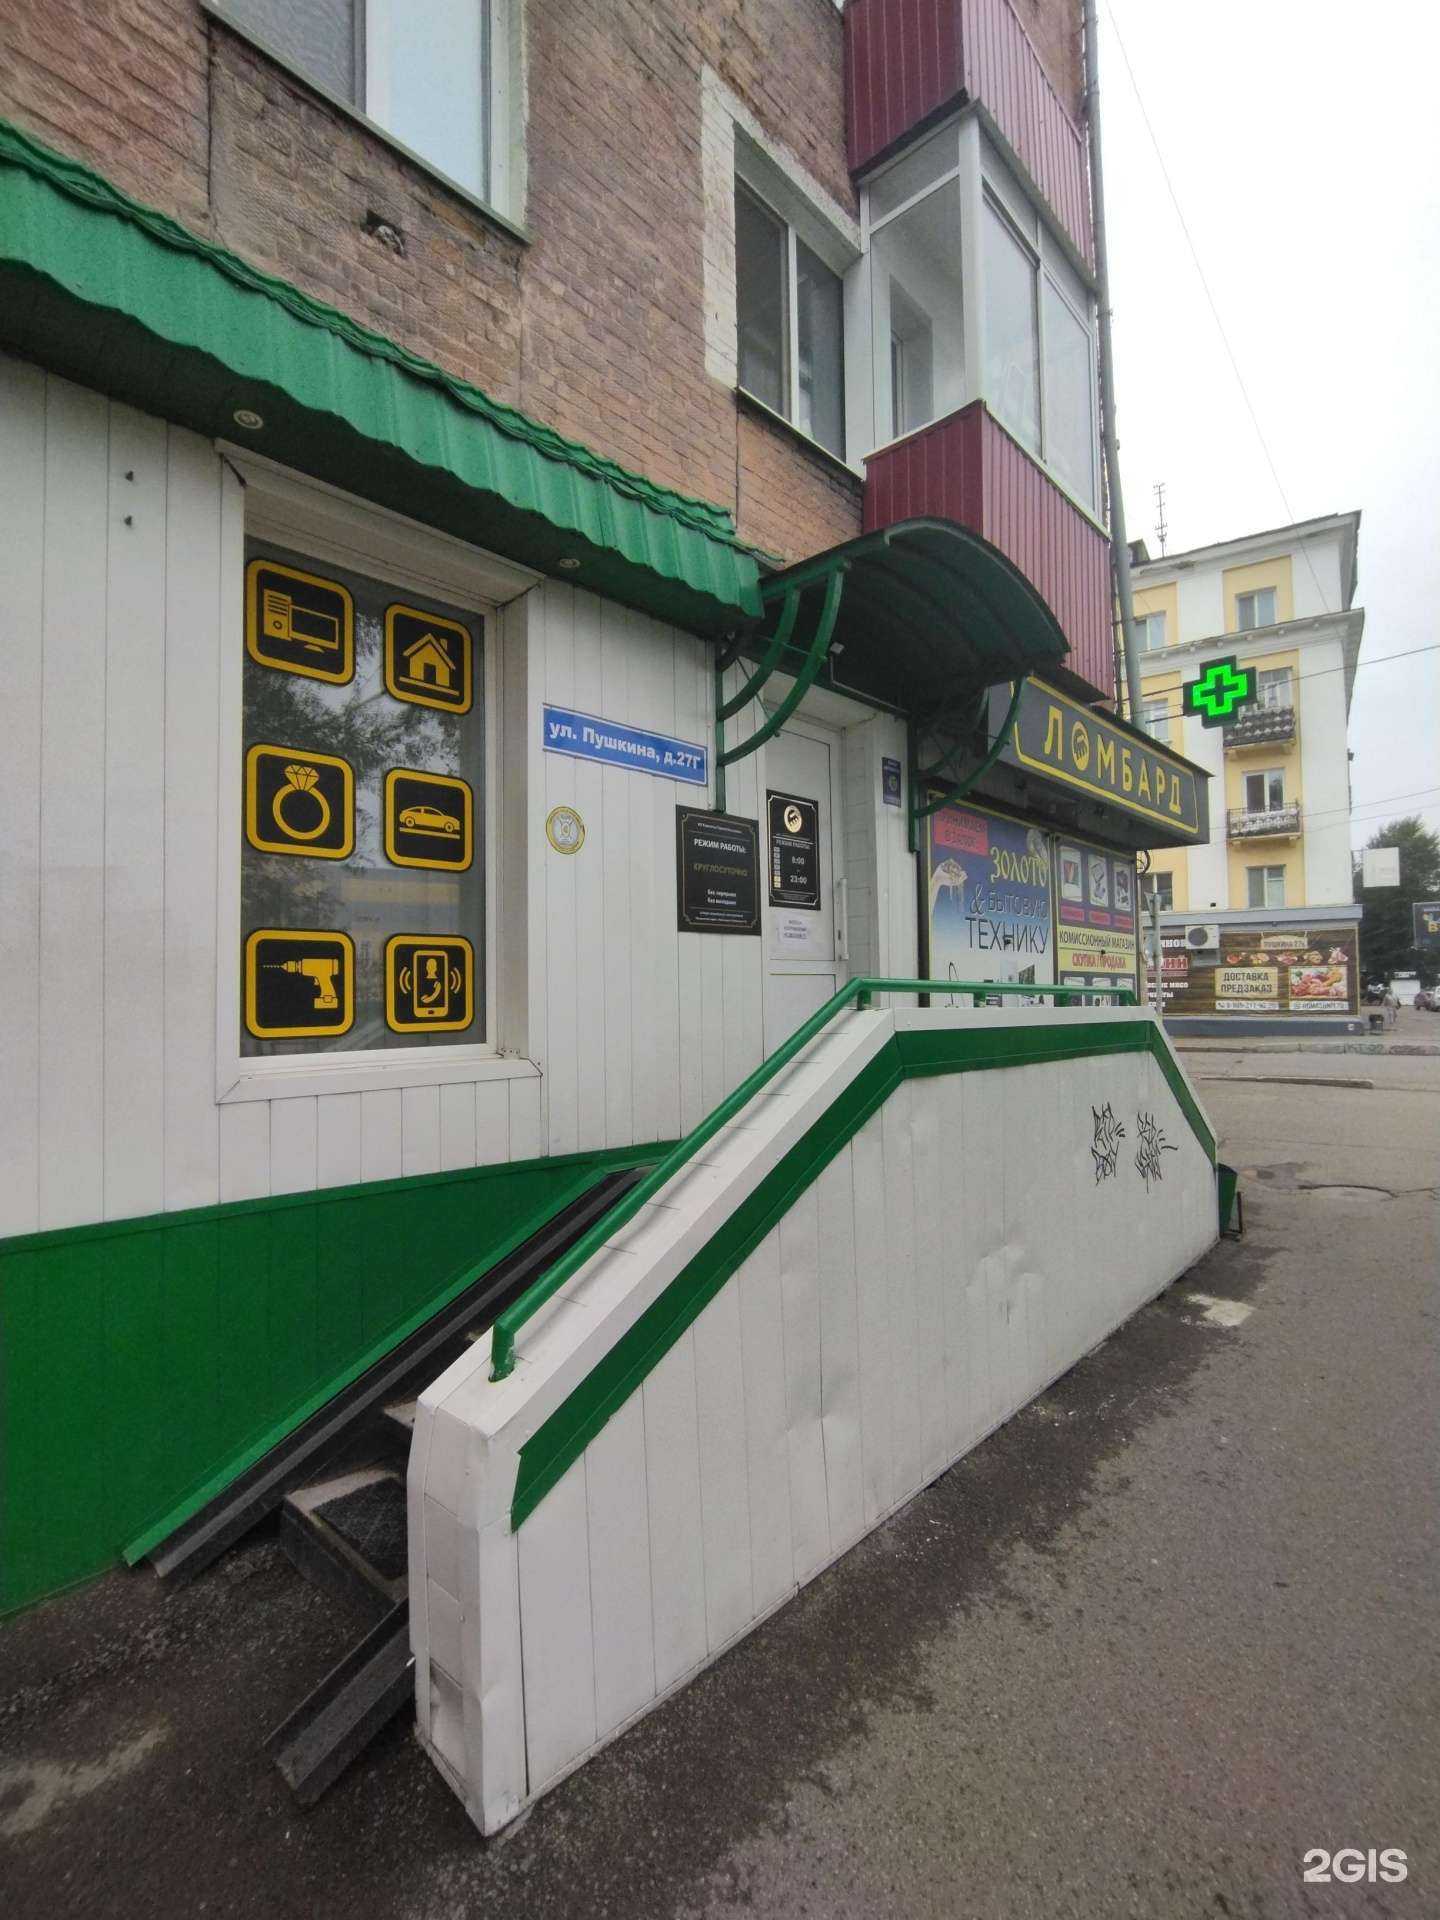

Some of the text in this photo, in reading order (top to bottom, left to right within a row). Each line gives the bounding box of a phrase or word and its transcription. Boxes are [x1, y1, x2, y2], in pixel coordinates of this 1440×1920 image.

[549, 722, 577, 739] ул.
[583, 727, 660, 763] Пушкина,
[1044, 705, 1182, 815] ЛОМБАРД
[694, 838, 719, 849] РЕЖИМ
[965, 917, 1049, 954] ТЕХНИКУ
[1059, 930, 1111, 948] КОМИССИОННЫЙ
[1224, 972, 1269, 981] ДОСТАВКА
[1221, 984, 1273, 994] ПРЕДЗАКАЗ
